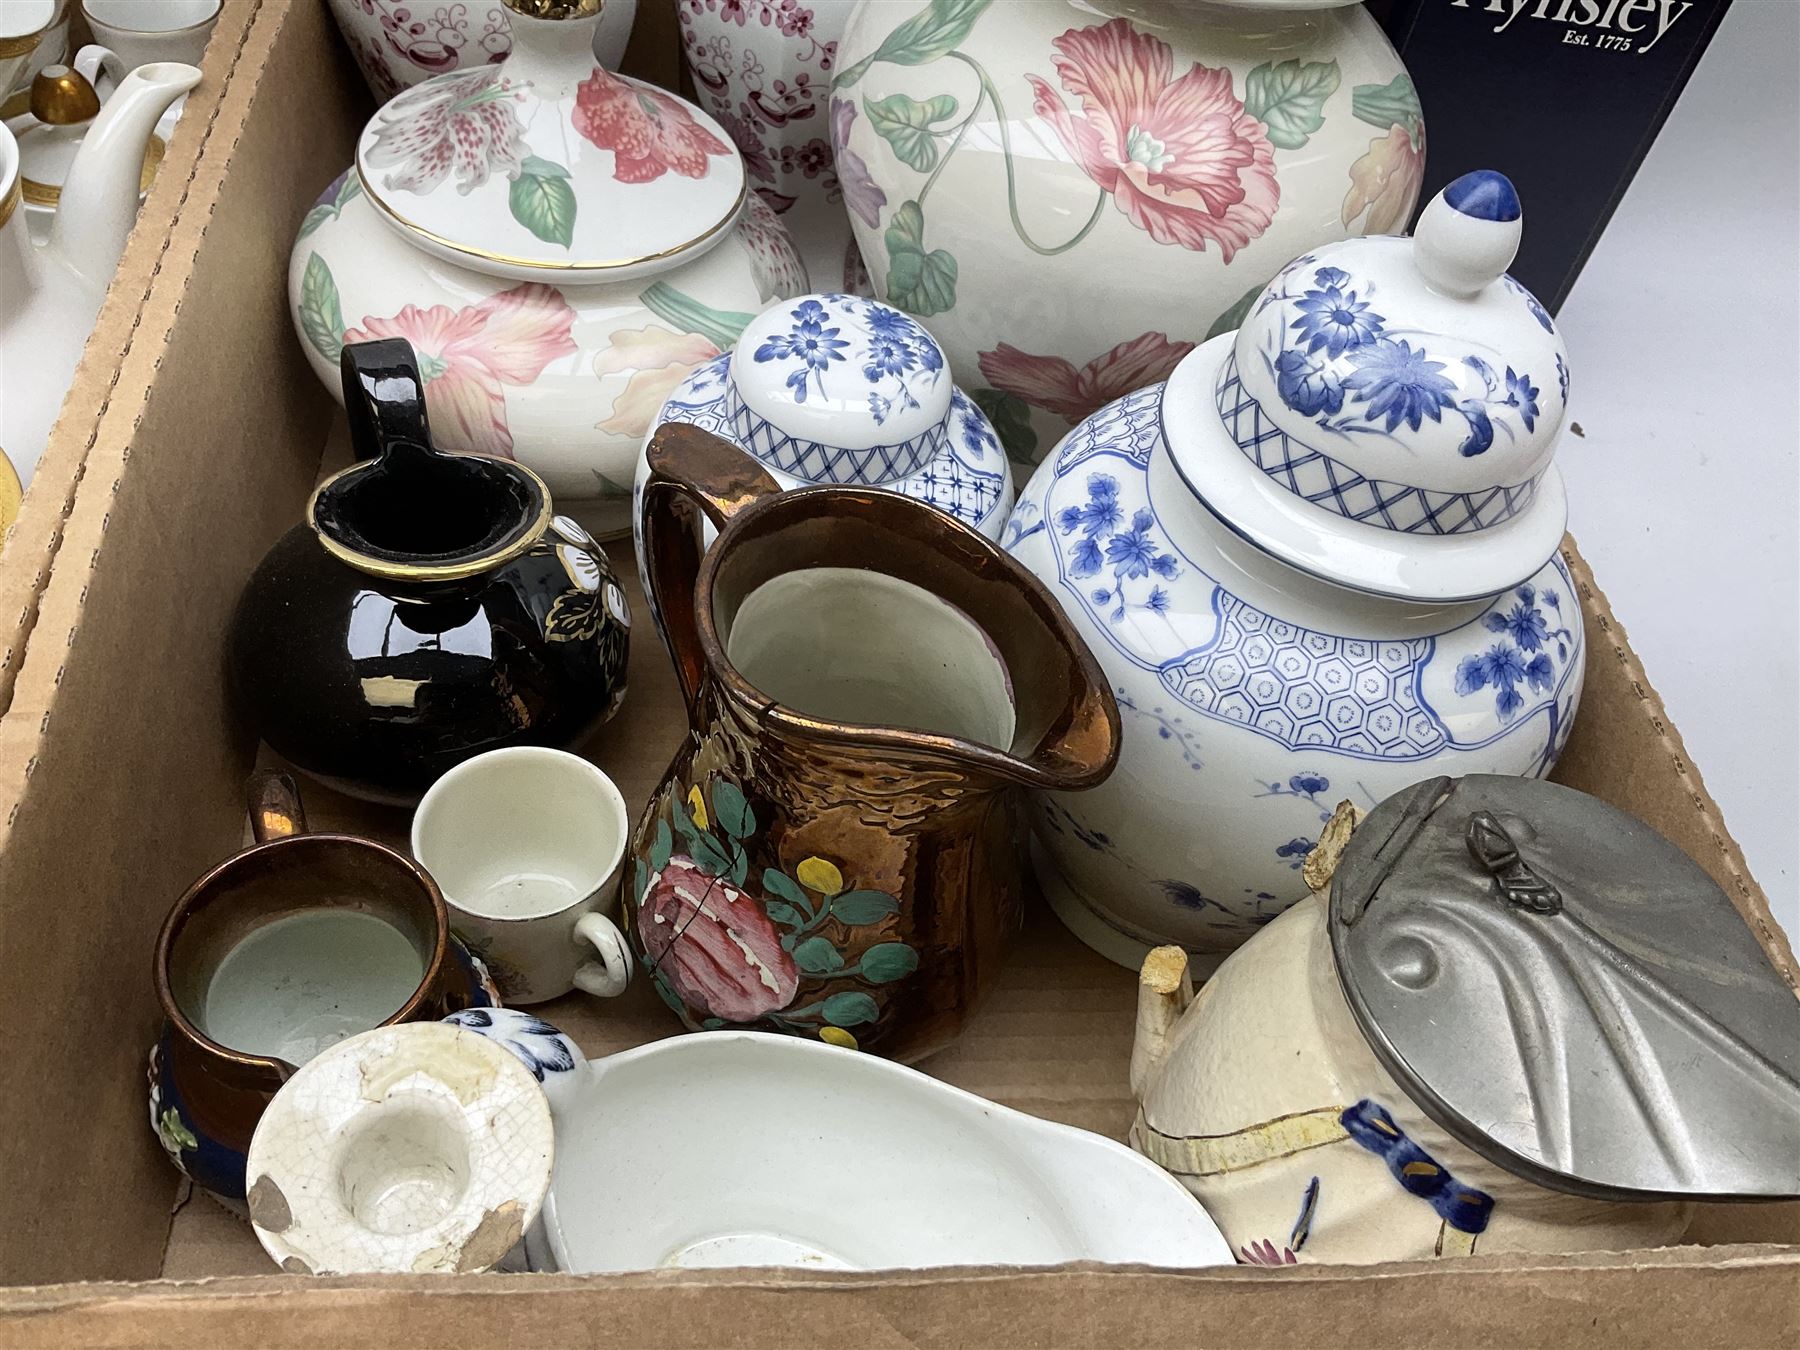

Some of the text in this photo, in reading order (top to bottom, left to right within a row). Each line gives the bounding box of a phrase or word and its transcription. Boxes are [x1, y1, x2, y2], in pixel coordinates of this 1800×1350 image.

[1451, 0, 1693, 54] ynsley
[1562, 30, 1632, 52] Est. 1775
